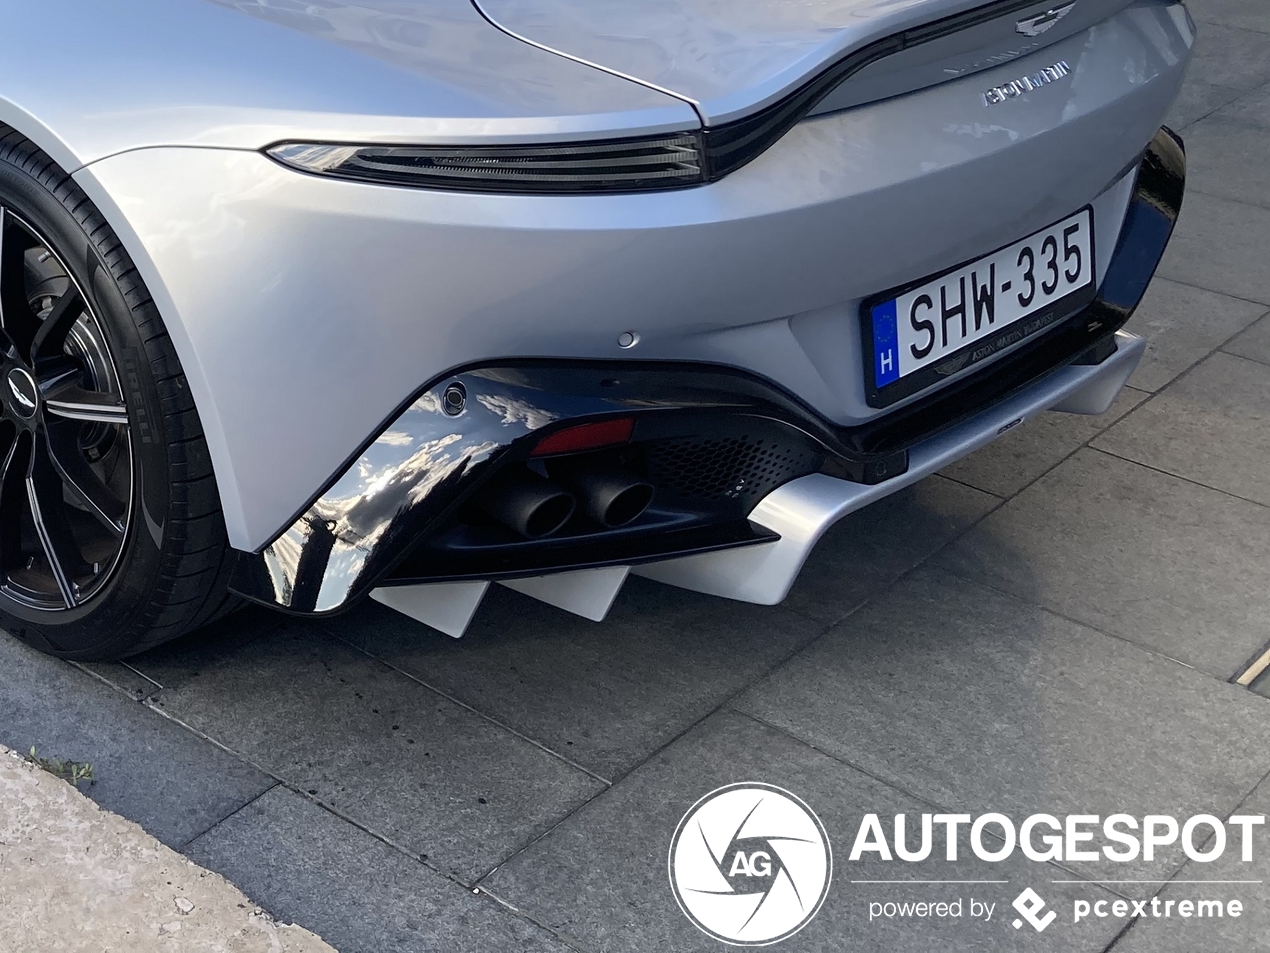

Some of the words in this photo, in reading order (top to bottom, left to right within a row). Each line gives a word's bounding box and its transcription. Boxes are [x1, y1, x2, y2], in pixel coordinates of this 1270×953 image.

[979, 79, 1027, 108] ASTON
[1022, 59, 1072, 92] MARTIN
[880, 348, 893, 375] H
[909, 222, 1083, 360] SHW-335
[971, 343, 996, 361] ASTON
[995, 331, 1023, 348] MARTIN
